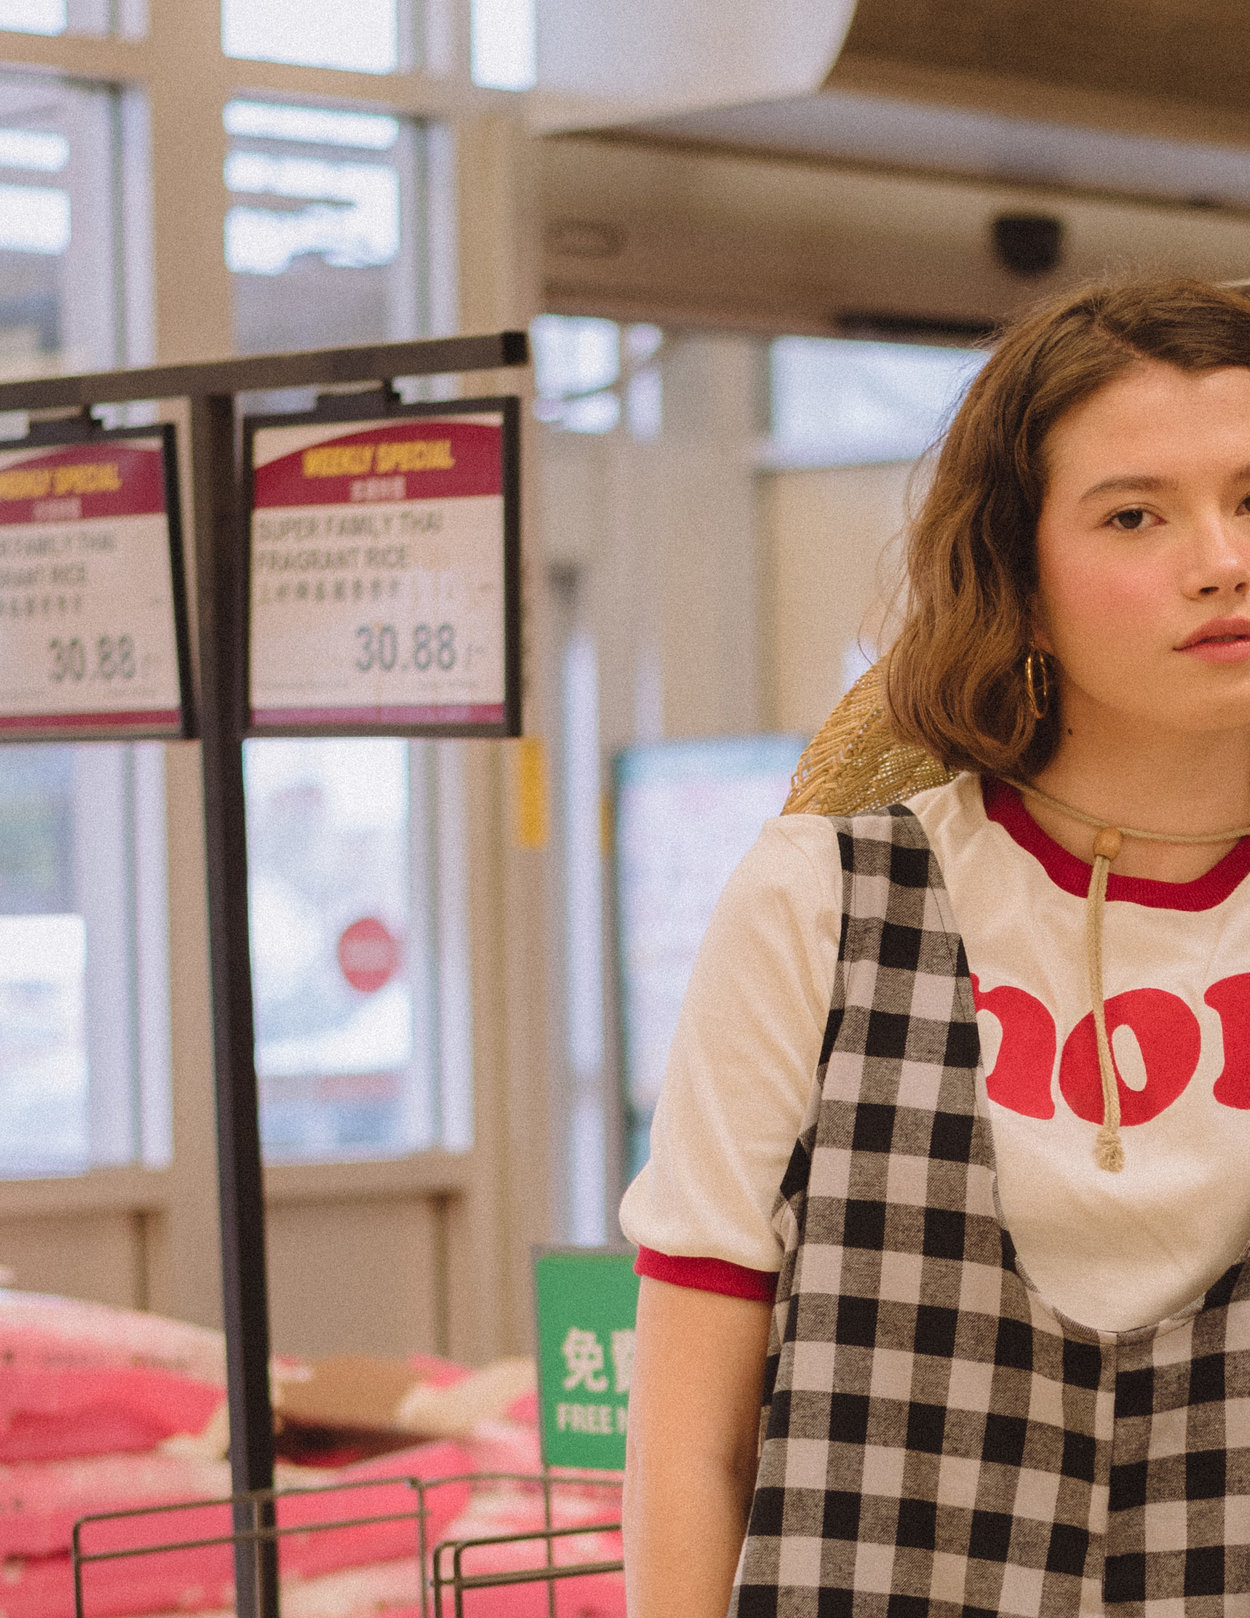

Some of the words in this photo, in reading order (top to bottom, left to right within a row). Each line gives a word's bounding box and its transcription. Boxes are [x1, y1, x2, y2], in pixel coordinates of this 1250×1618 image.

[48, 634, 136, 681] 30.88
[355, 622, 455, 672] 30.88
[557, 1402, 613, 1434] FREE
